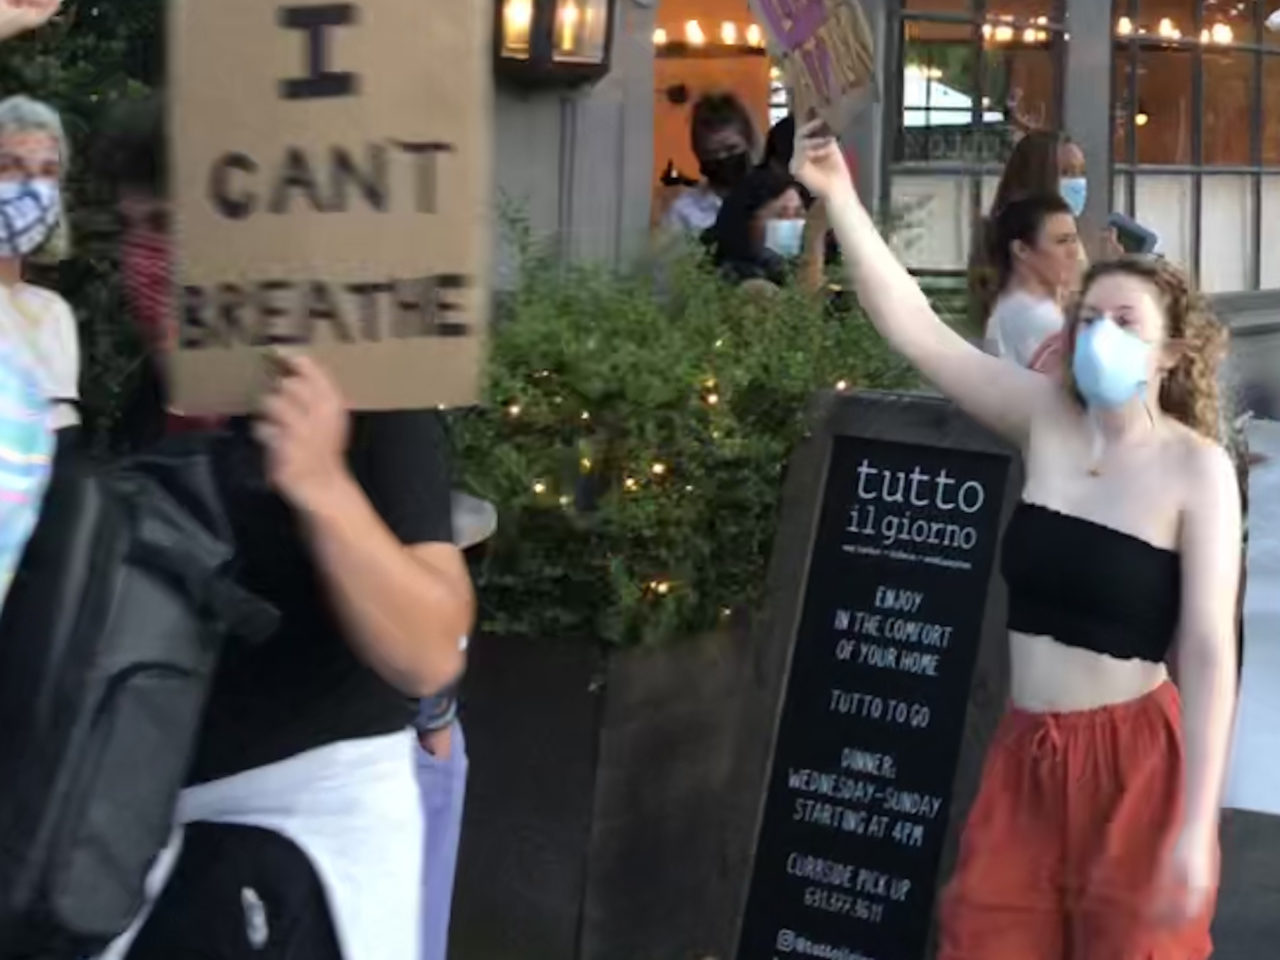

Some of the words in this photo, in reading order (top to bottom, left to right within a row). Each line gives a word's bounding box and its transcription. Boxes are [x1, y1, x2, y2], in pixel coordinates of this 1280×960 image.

[276, 3, 358, 100] I
[178, 273, 473, 350] BREATHE
[857, 458, 985, 513] tutto
[846, 505, 876, 535] il
[880, 511, 978, 550] giorno
[874, 585, 924, 613] ENJOY
[834, 609, 850, 630] IN
[854, 611, 882, 637] THE
[884, 617, 953, 648] COMFORT
[836, 638, 856, 660] OF
[858, 642, 898, 670] YOUR
[900, 650, 940, 677] HOME
[829, 689, 884, 720] TUTTO
[886, 700, 908, 723] TO
[792, 797, 867, 835] STARTING
[867, 814, 890, 838] AT
[892, 820, 925, 847] 4PM
[856, 868, 890, 896] PICK
